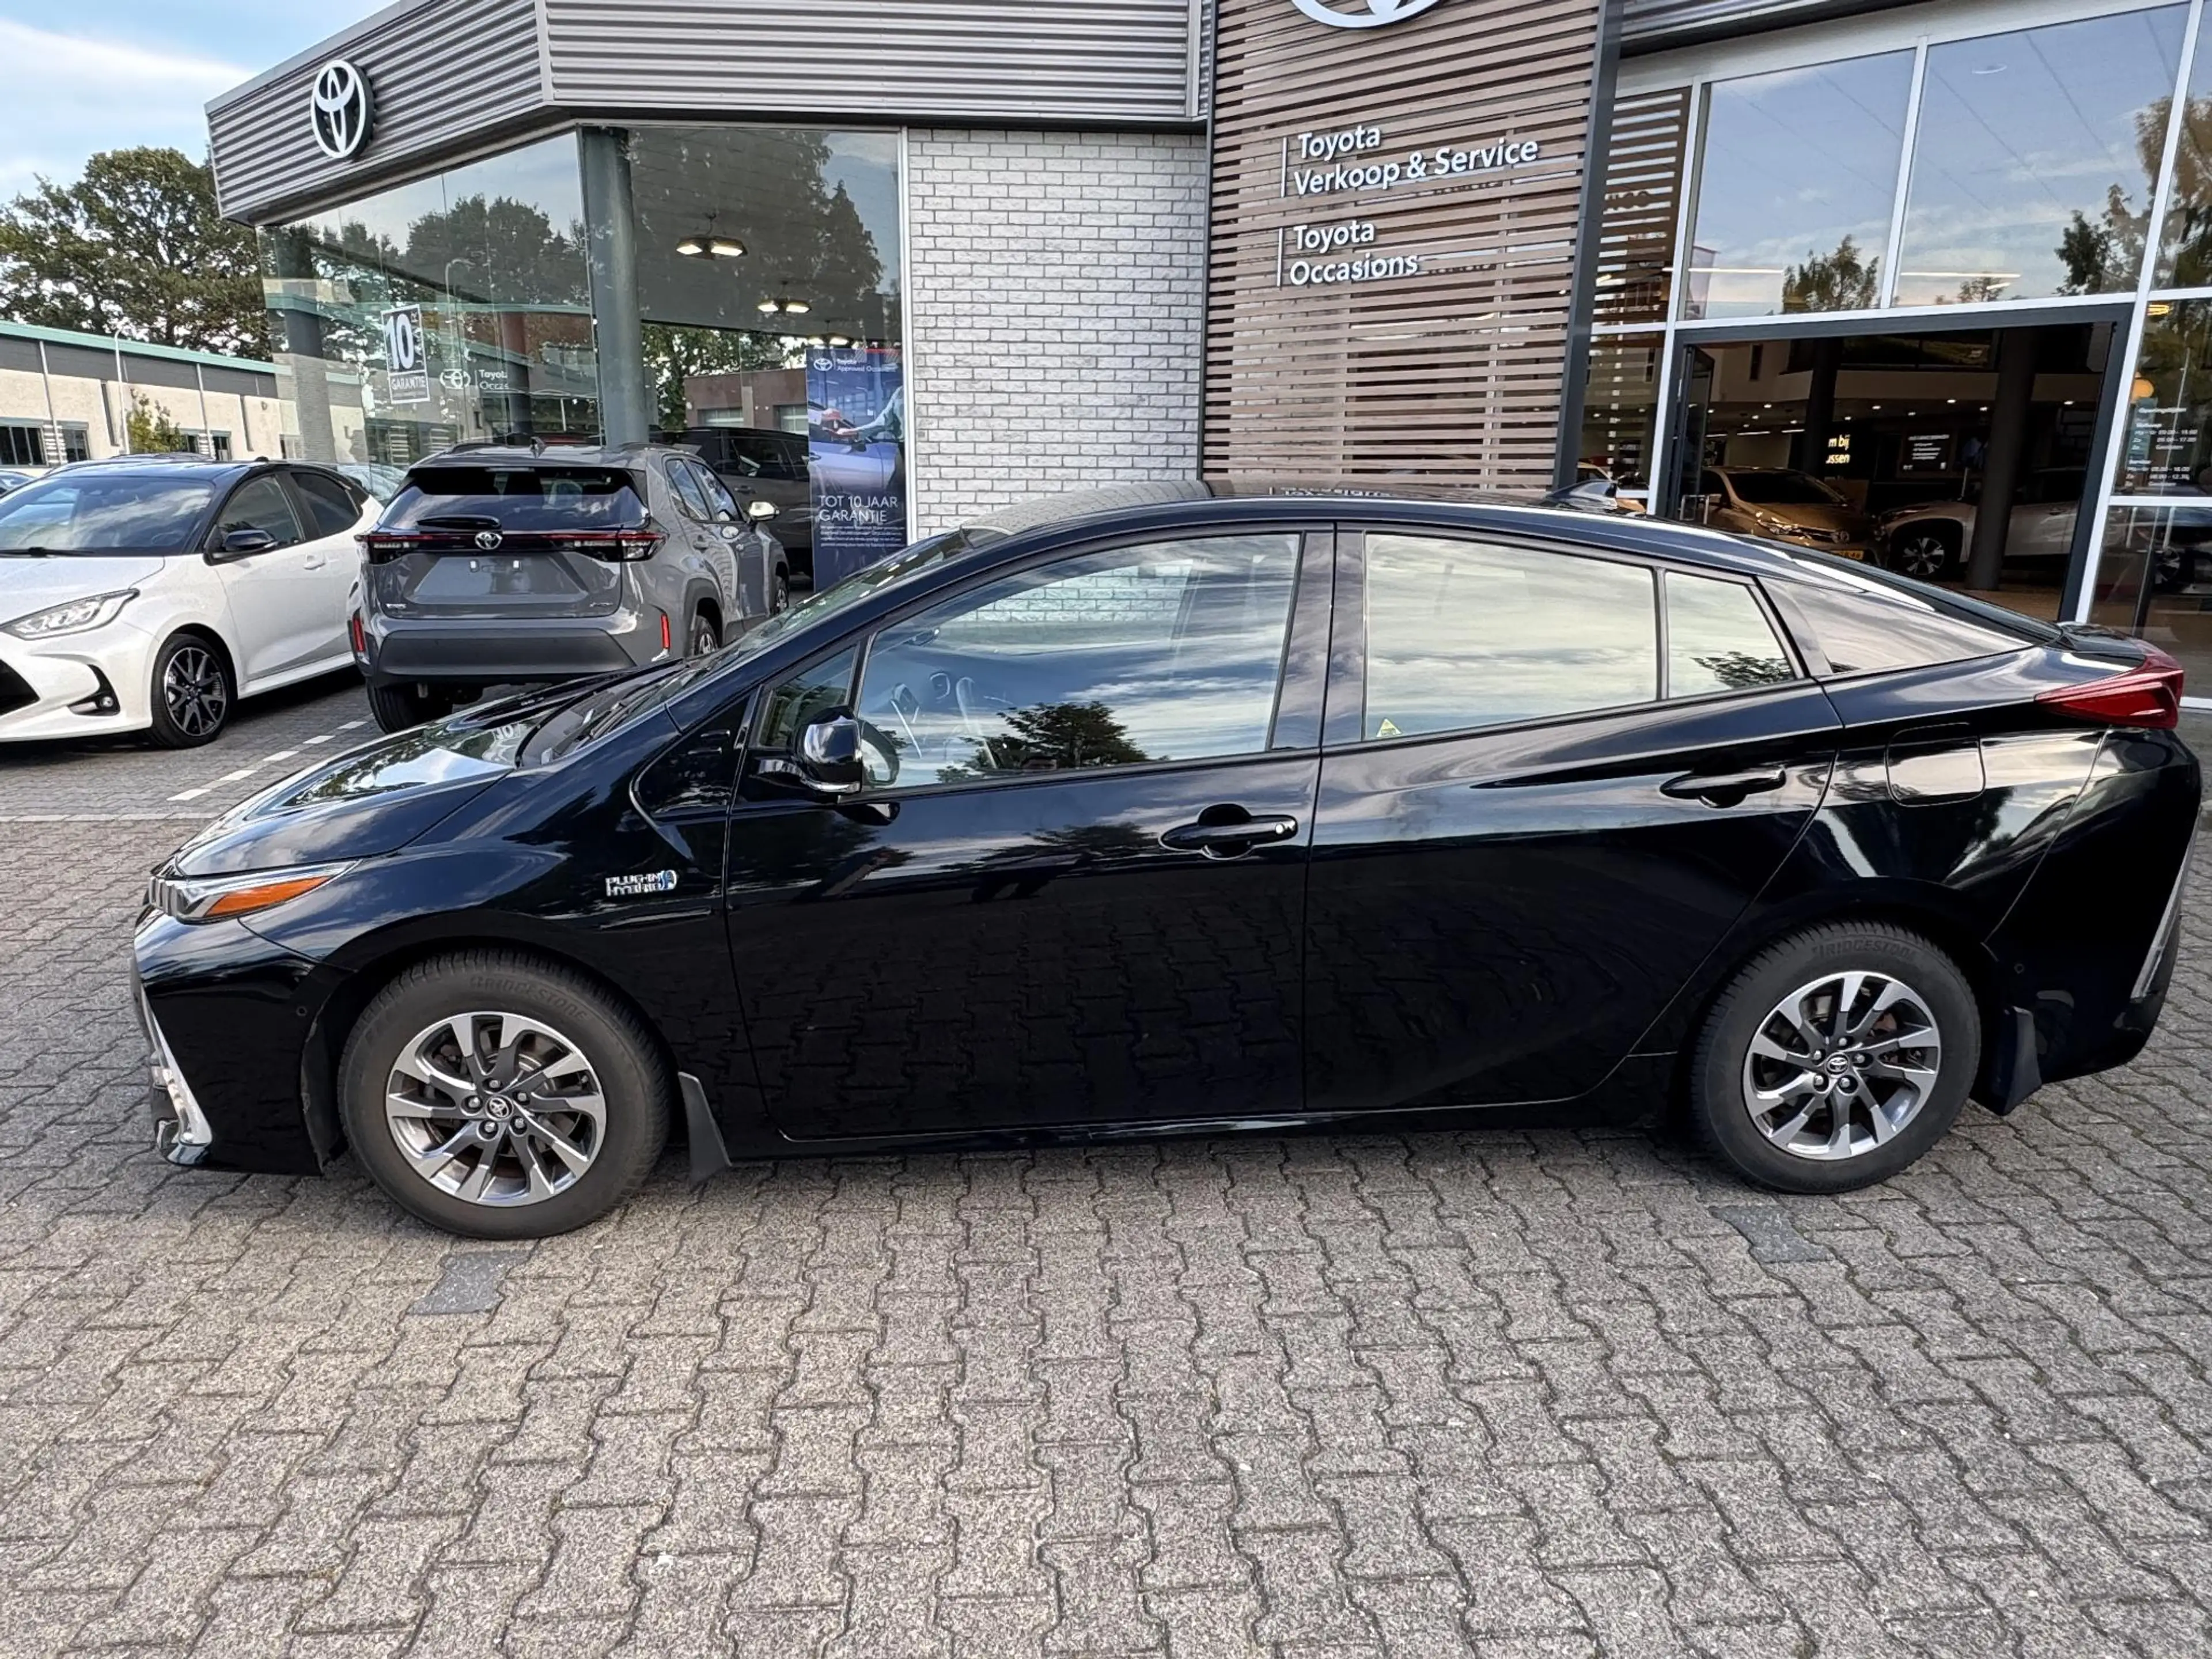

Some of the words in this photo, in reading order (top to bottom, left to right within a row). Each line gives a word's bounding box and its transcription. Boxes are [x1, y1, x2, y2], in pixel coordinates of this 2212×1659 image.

[1298, 125, 1381, 161] Toyota
[1294, 162, 1399, 196] Verkoop
[1406, 151, 1427, 180] &
[1434, 138, 1539, 175] Service
[1293, 220, 1375, 253] Toyota
[1289, 252, 1419, 286] Occasions
[819, 495, 844, 507] TOT
[848, 495, 862, 507] 10
[864, 496, 898, 508] JAAR
[819, 509, 888, 522] GARANTIE
